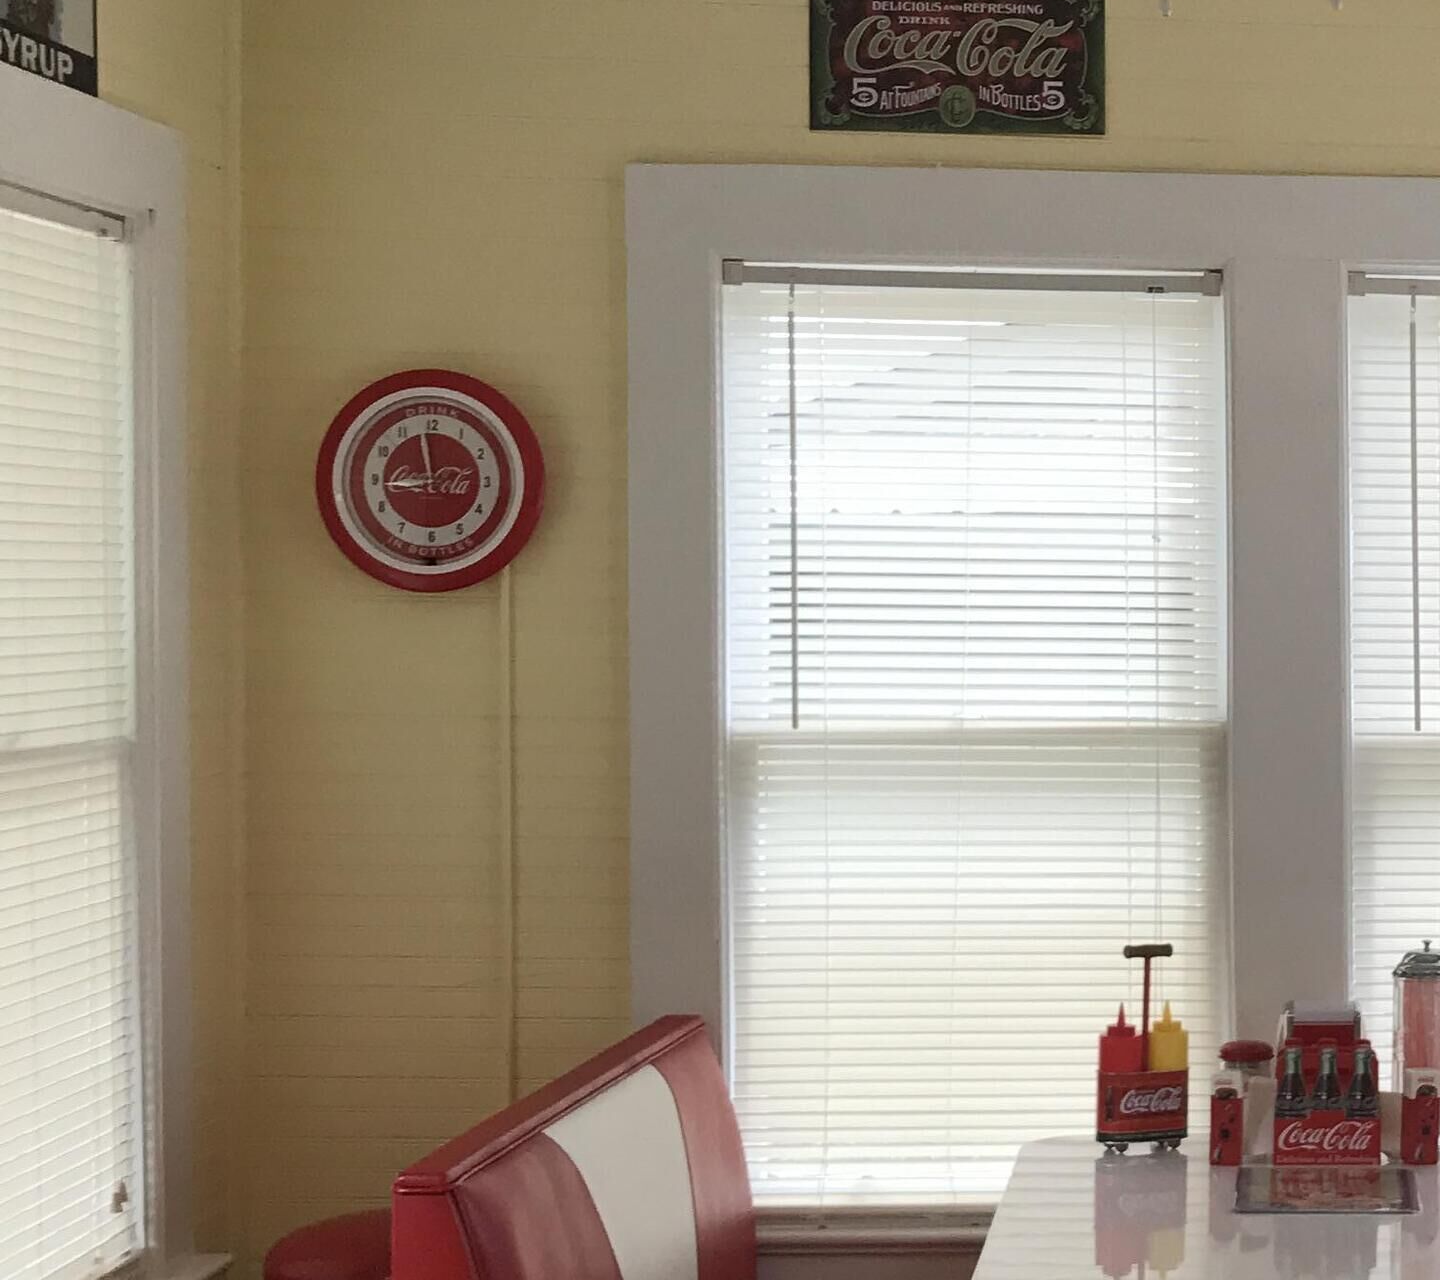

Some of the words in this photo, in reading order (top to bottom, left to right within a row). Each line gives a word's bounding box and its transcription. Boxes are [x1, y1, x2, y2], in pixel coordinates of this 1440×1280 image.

[872, 1, 942, 13] DELICIOUS
[963, 1, 1043, 15] REFRESHING
[899, 16, 950, 25] DRINK
[893, 82, 943, 108] FOUNTAINS
[978, 85, 990, 101] IN
[990, 84, 1042, 112] BOTTLES
[405, 406, 460, 418] DRINK
[426, 420, 439, 431] 12
[459, 429, 464, 439] 1
[378, 445, 389, 457] 10
[477, 449, 485, 460] 2
[371, 474, 379, 486] 9
[484, 477, 491, 488] 3
[378, 501, 386, 513] 8
[475, 504, 483, 514] 4
[398, 522, 406, 534] 7
[456, 524, 464, 535] 5
[428, 531, 435, 542] 6
[408, 538, 475, 555] BOTTLES
